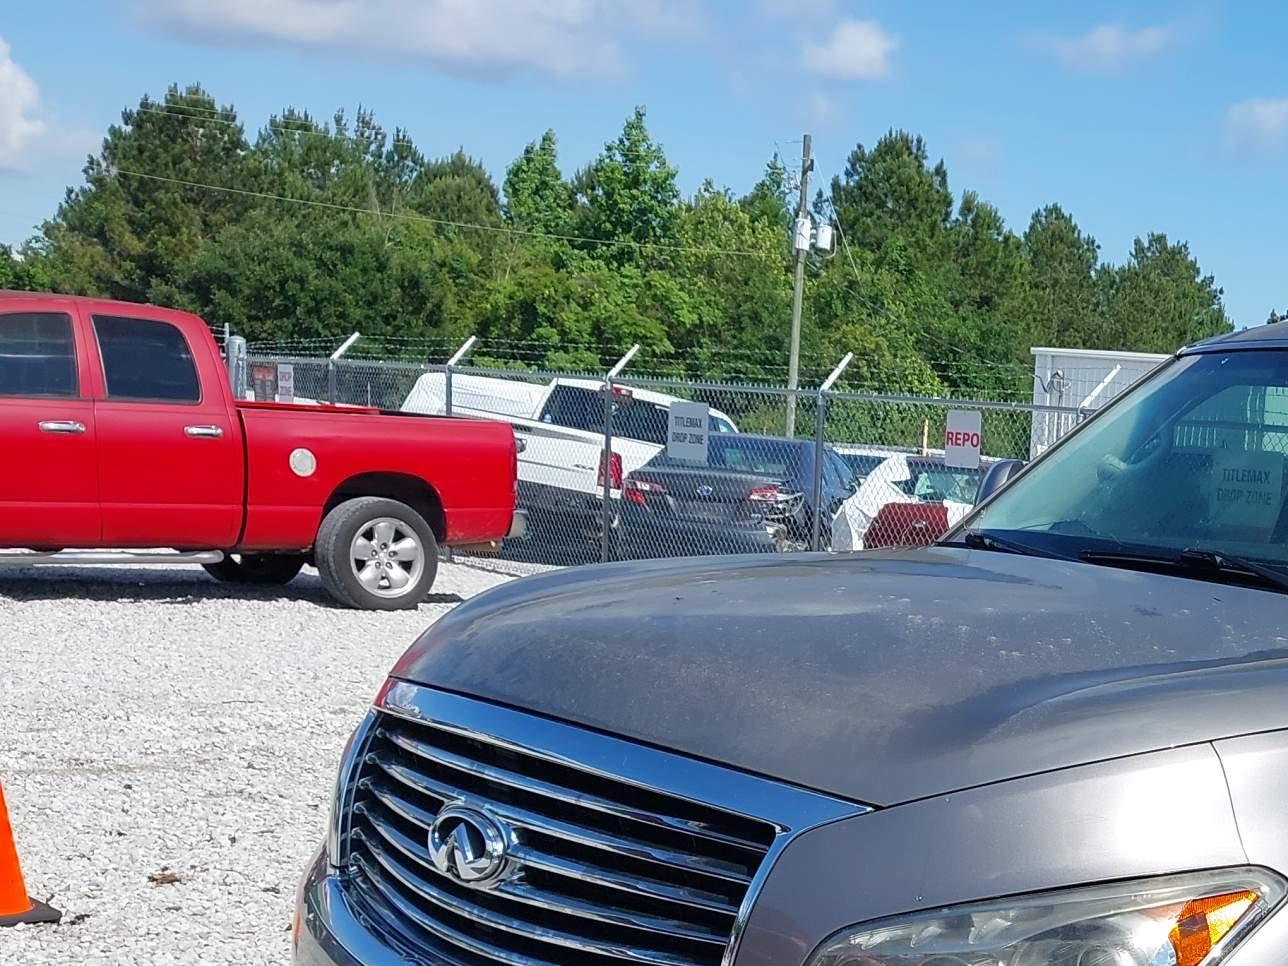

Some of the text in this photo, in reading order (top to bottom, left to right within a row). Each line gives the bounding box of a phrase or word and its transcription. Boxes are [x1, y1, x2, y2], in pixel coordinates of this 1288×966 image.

[674, 415, 703, 429] TITLEMAX
[946, 431, 980, 448] REPO
[1223, 468, 1271, 485] TITLEMAX
